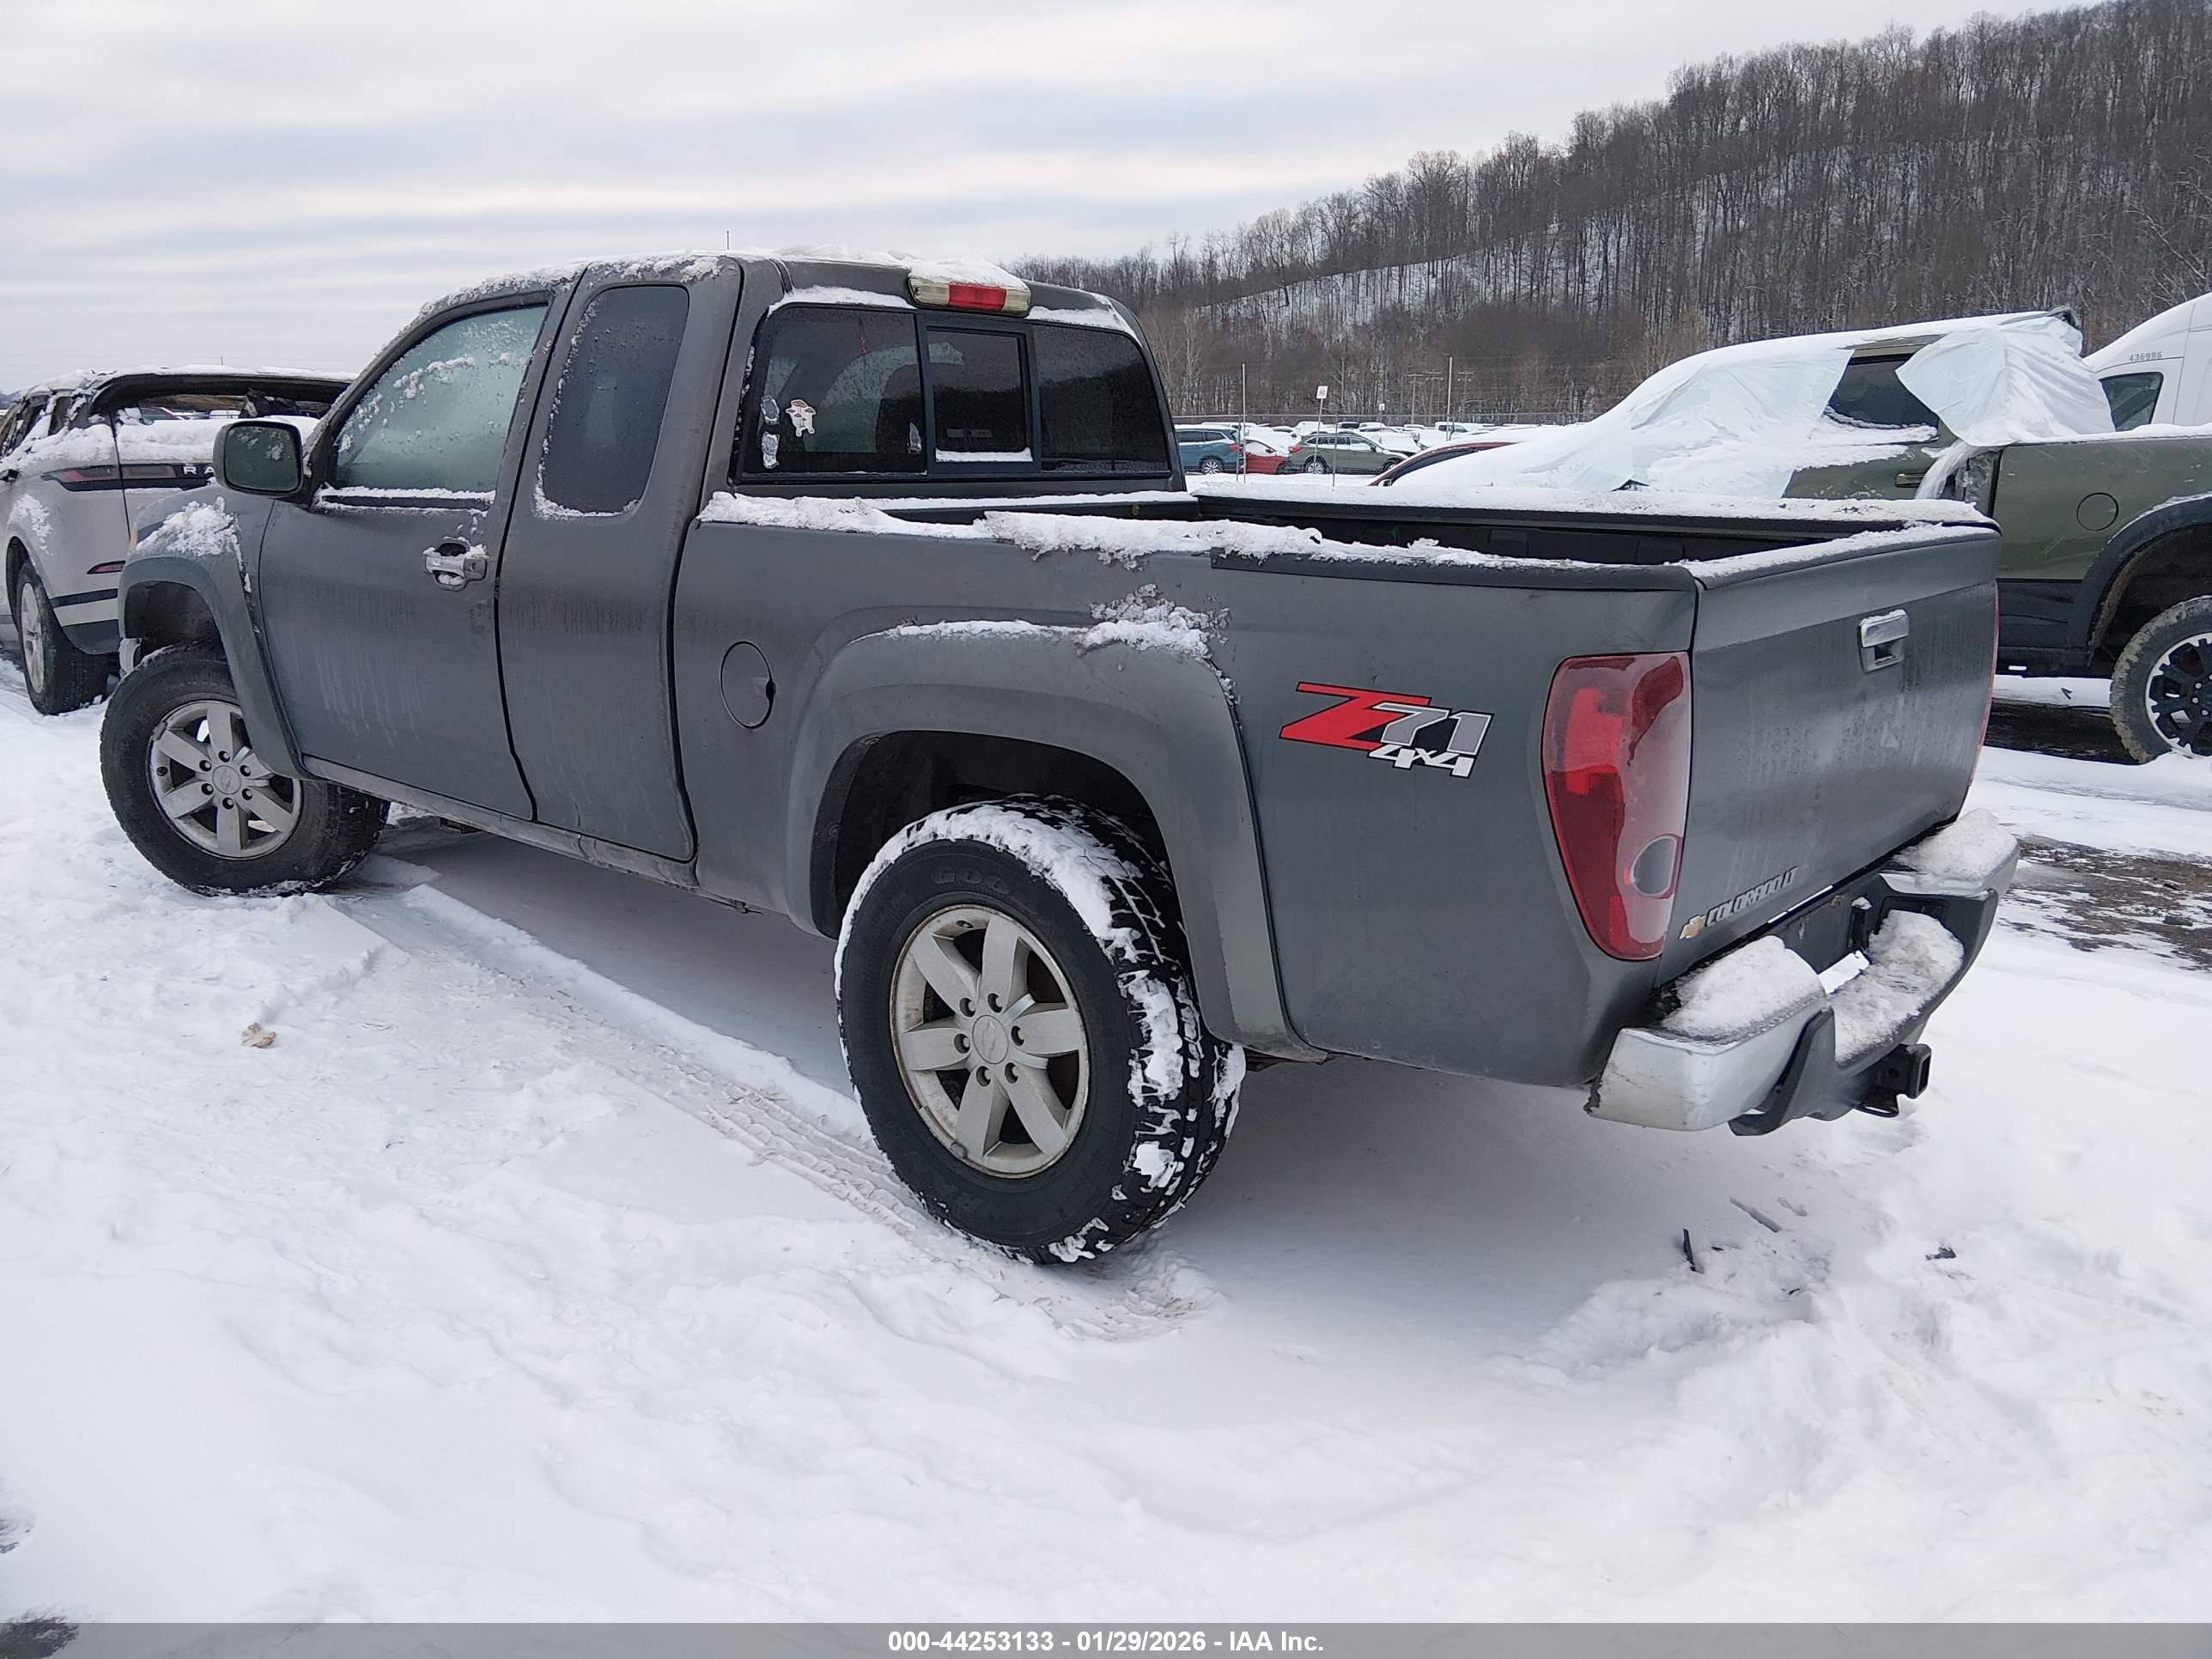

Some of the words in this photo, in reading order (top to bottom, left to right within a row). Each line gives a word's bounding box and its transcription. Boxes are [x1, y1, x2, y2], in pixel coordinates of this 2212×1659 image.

[2129, 351, 2162, 362] 436996
[1279, 681, 1494, 756] Z71
[1706, 874, 1784, 927] COLORADO
[1782, 866, 1798, 888] LT
